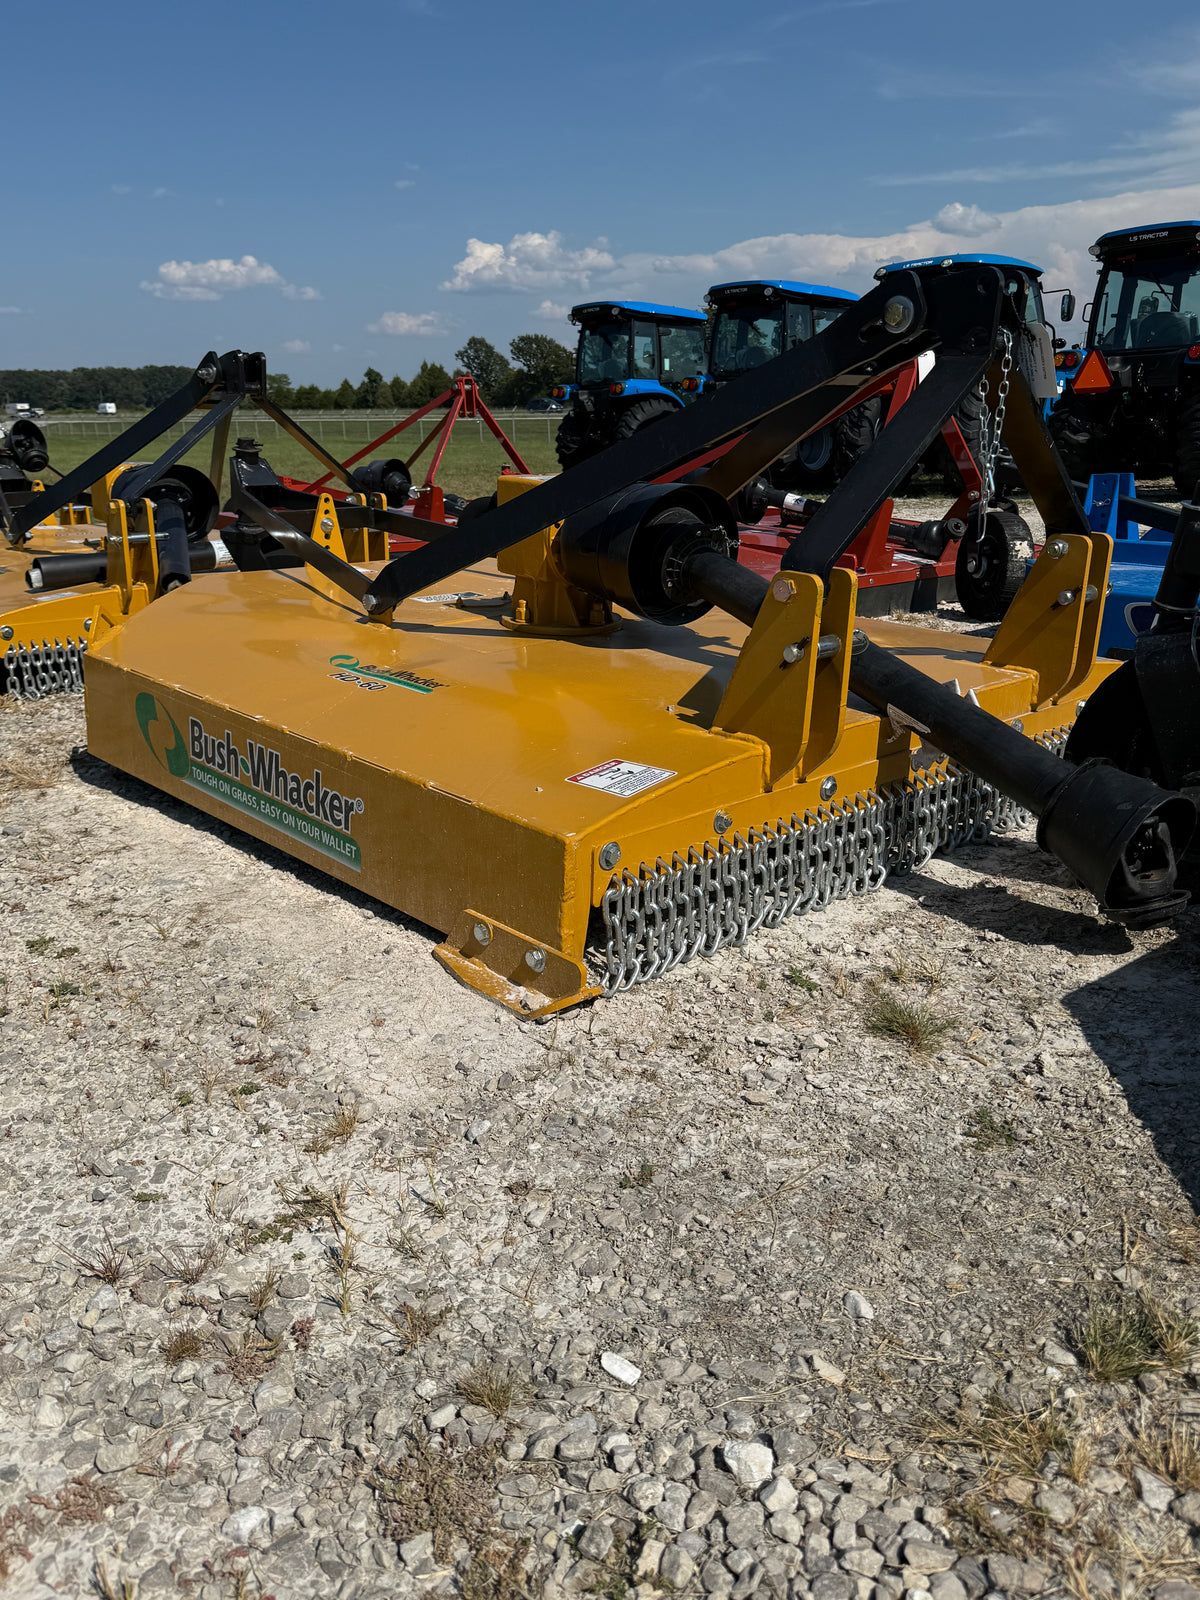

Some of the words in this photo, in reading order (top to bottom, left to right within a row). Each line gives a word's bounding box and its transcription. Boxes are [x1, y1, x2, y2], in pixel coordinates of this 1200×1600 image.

[1139, 231, 1169, 240] TRACTOR
[192, 766, 218, 789] TOUGH
[218, 780, 231, 796] ON
[231, 787, 260, 811] GRASS,
[260, 800, 281, 820] EASY
[282, 812, 295, 828] ON
[296, 819, 320, 841] YOUR
[321, 830, 357, 859] WALLET
